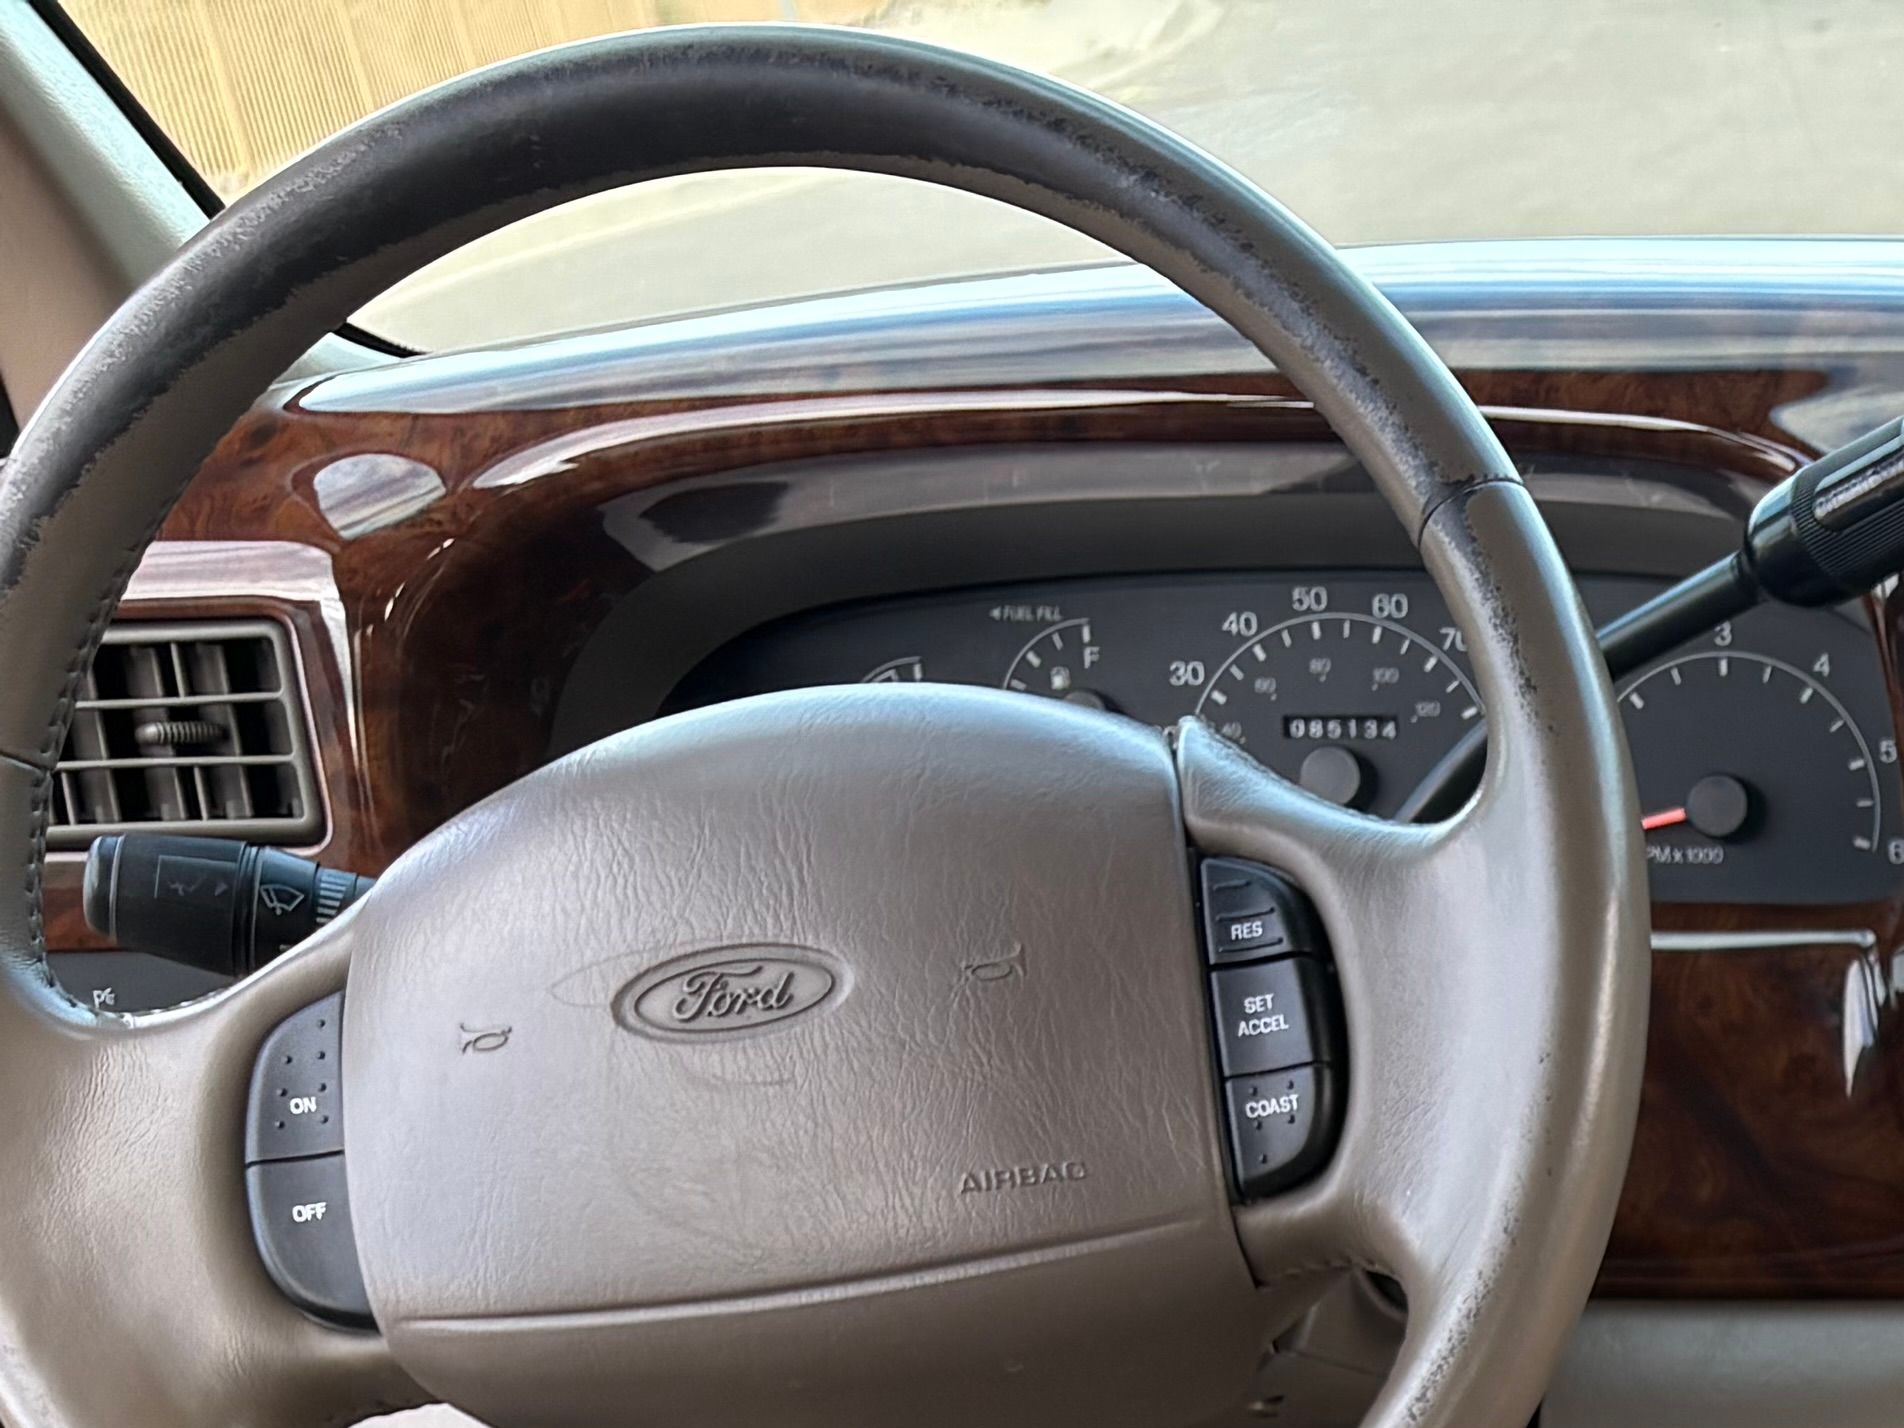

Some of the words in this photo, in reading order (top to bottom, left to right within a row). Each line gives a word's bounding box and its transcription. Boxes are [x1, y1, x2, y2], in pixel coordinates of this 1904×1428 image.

[1292, 587, 1328, 611] 50
[1372, 594, 1408, 618] 60
[1003, 605, 1033, 621] FUEL
[1036, 606, 1062, 621] FILL
[1223, 612, 1258, 637] 40
[1714, 620, 1732, 647] 3
[1084, 646, 1100, 669] F
[1813, 652, 1830, 677] 4
[1169, 661, 1205, 686] 30
[1880, 739, 1898, 763] 5
[1687, 846, 1725, 864] 1000
[1230, 921, 1264, 941] RES
[672, 965, 795, 1024] Ford
[1243, 993, 1274, 1014] SET
[1238, 1014, 1289, 1038] ACCEL
[289, 1096, 317, 1115] ON
[1245, 1094, 1300, 1119] COAST
[961, 1160, 1088, 1195] AIRBAG
[292, 1202, 327, 1223] OFF
